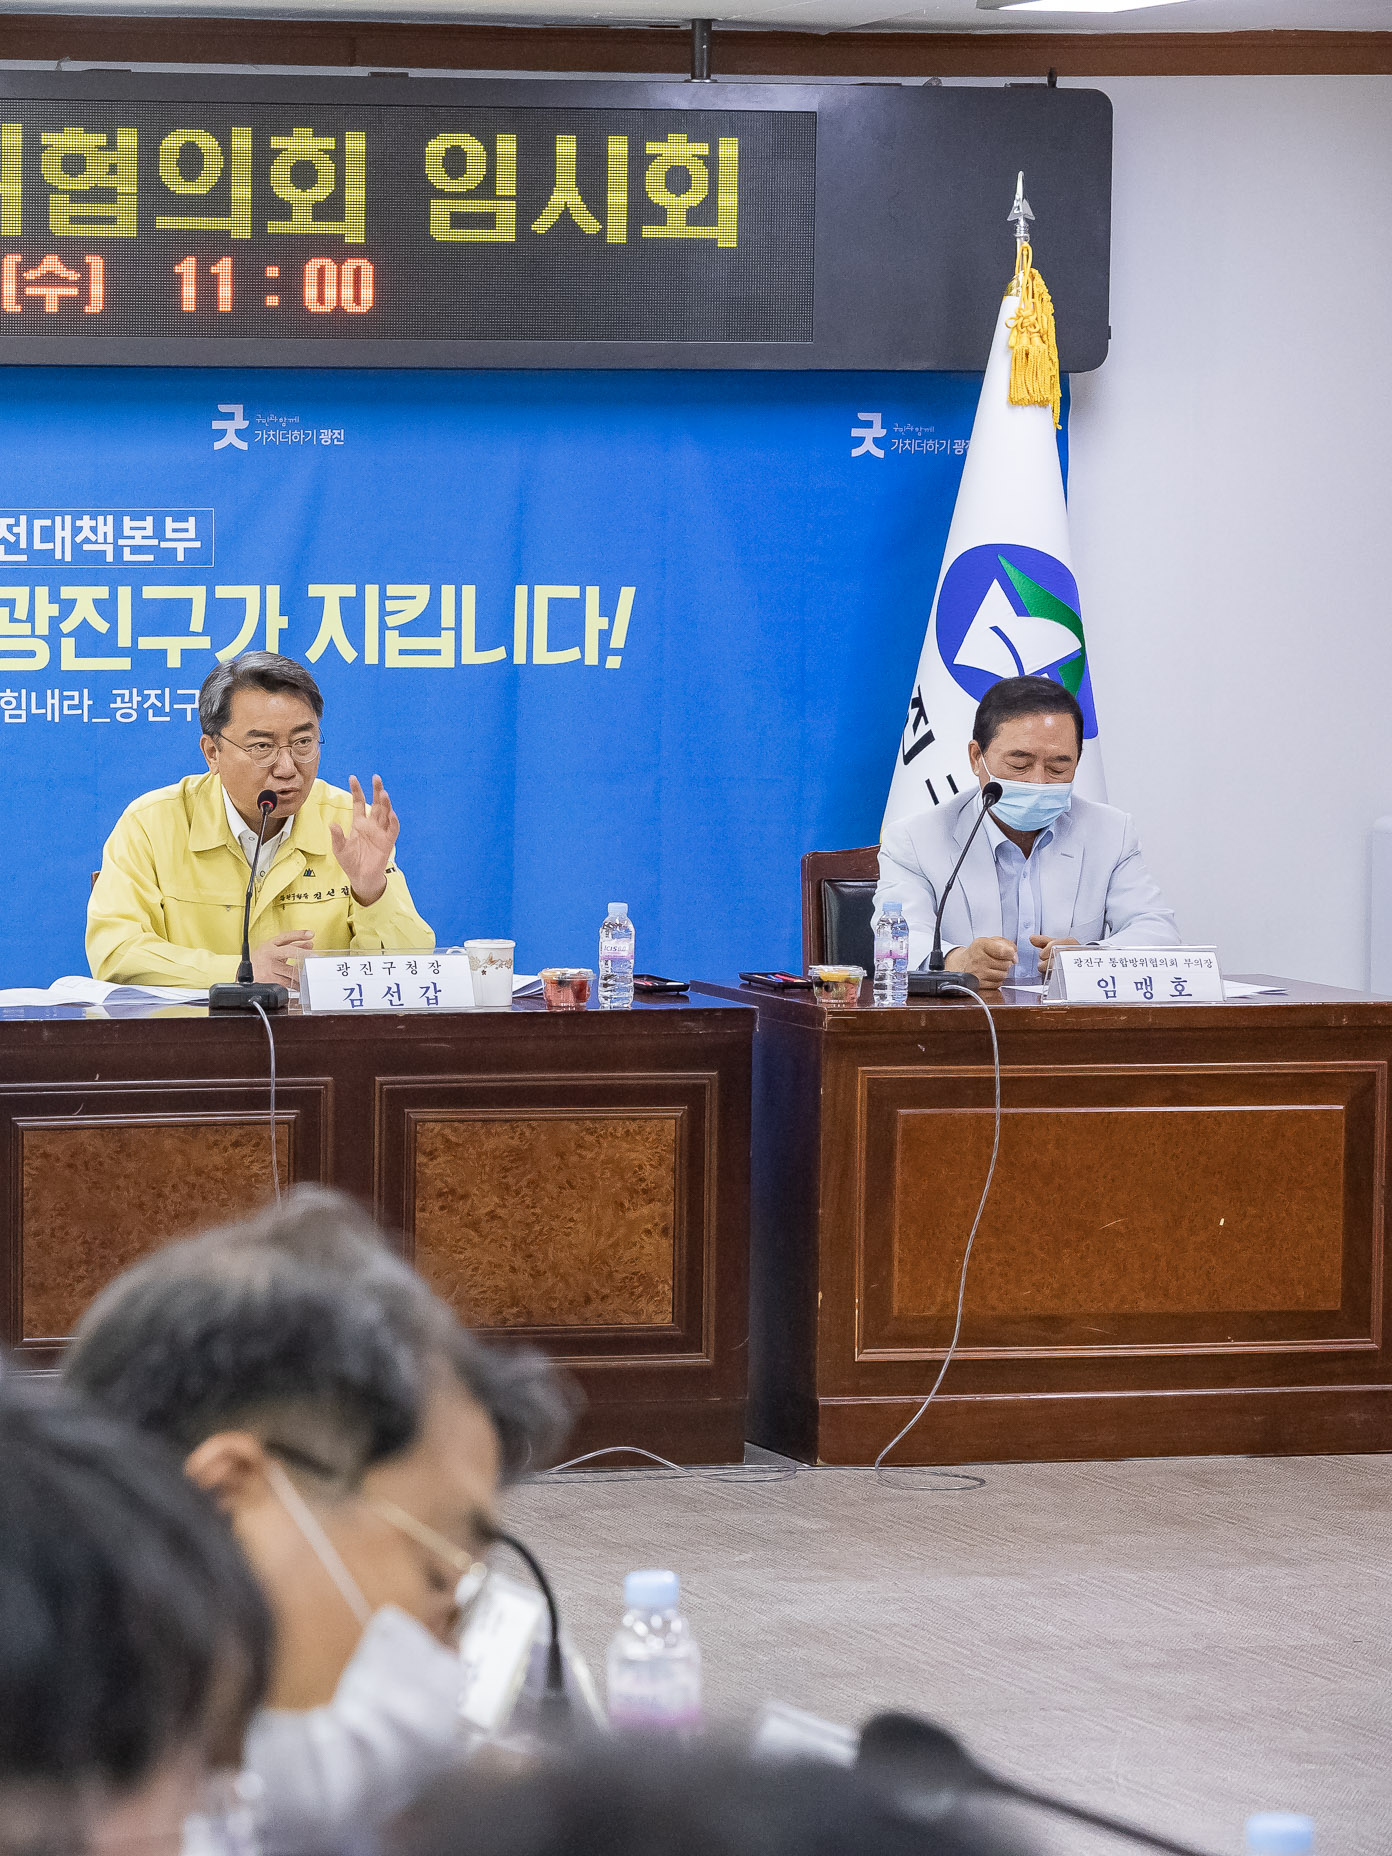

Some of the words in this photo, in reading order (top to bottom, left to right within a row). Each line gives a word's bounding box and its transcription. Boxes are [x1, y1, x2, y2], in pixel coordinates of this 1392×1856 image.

[424, 133, 739, 248] 임시회
[254, 429, 317, 446] 가치더하기
[318, 428, 345, 446] 광진
[890, 437, 951, 455] 가치더하기
[305, 583, 637, 670] 지킵니다!
[1073, 957, 1104, 968] 광진구
[1183, 958, 1213, 969] 부의장
